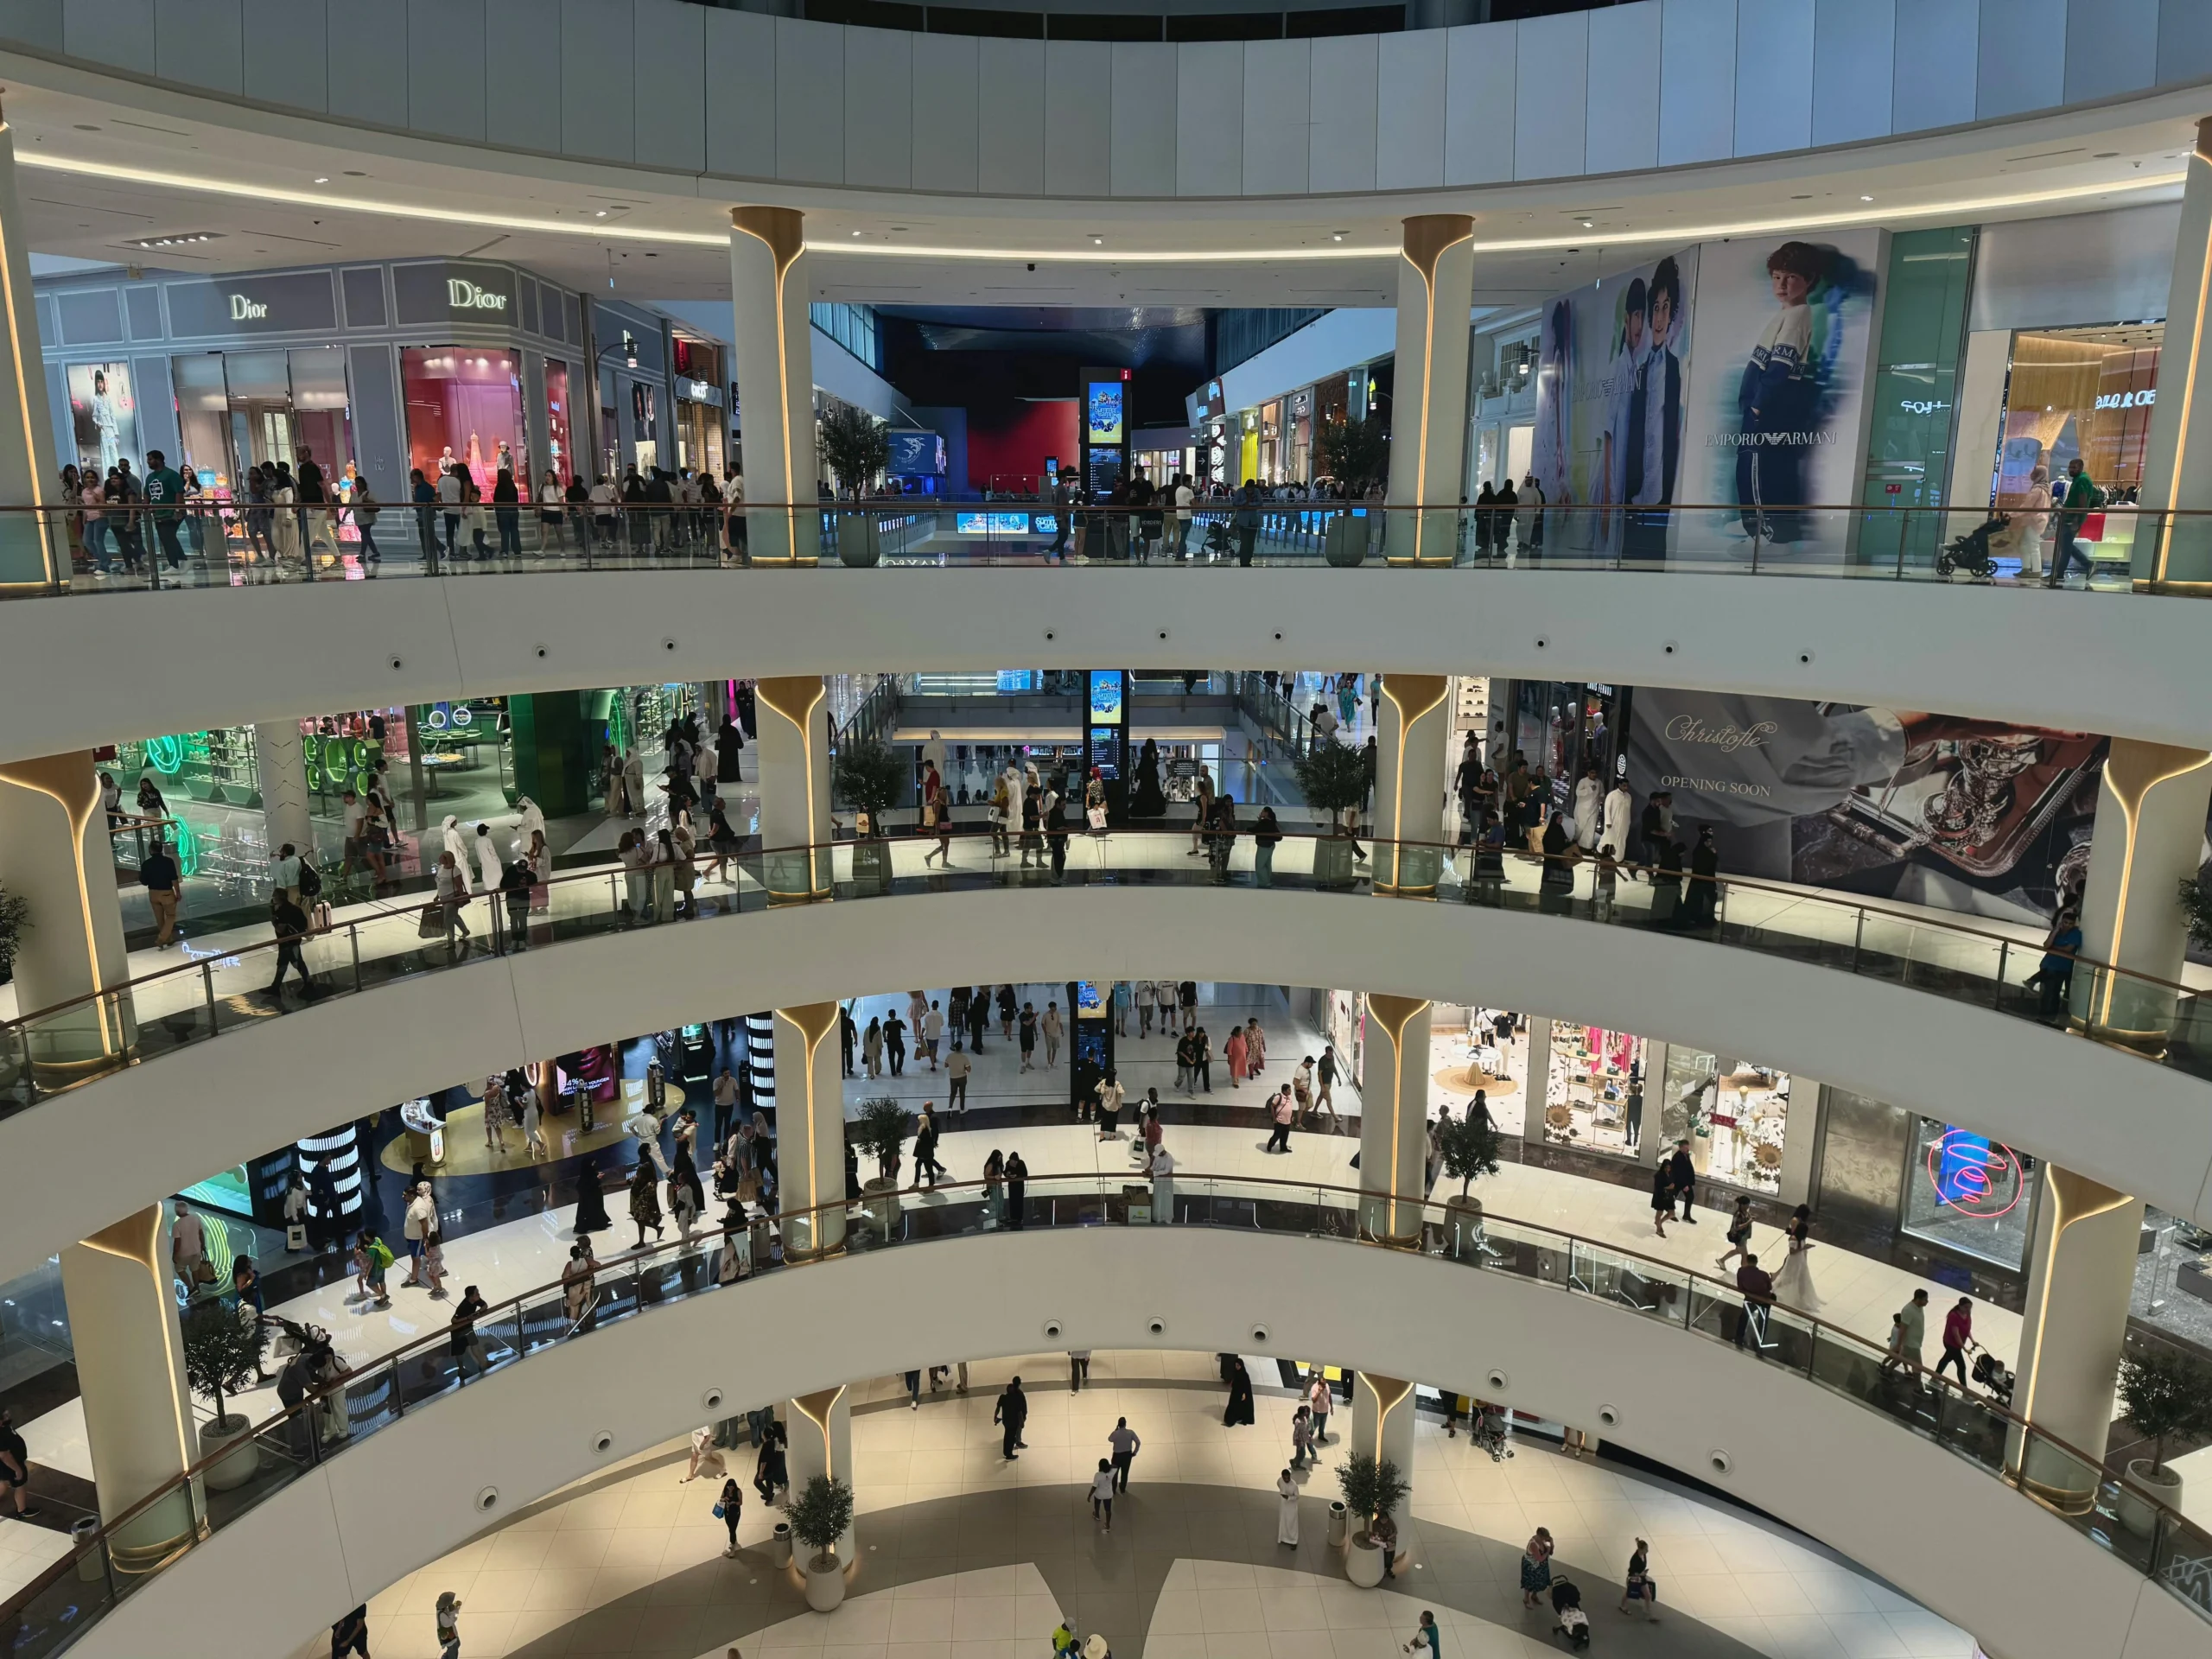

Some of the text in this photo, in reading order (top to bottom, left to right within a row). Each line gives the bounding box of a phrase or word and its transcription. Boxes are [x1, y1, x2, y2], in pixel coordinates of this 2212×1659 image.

[447, 278, 507, 309] Dior
[228, 294, 267, 320] Dior
[1705, 431, 1837, 447] EMPORIO ARMANI
[1665, 714, 1777, 753] Christofle
[1661, 775, 1770, 797] OPENING SOON
